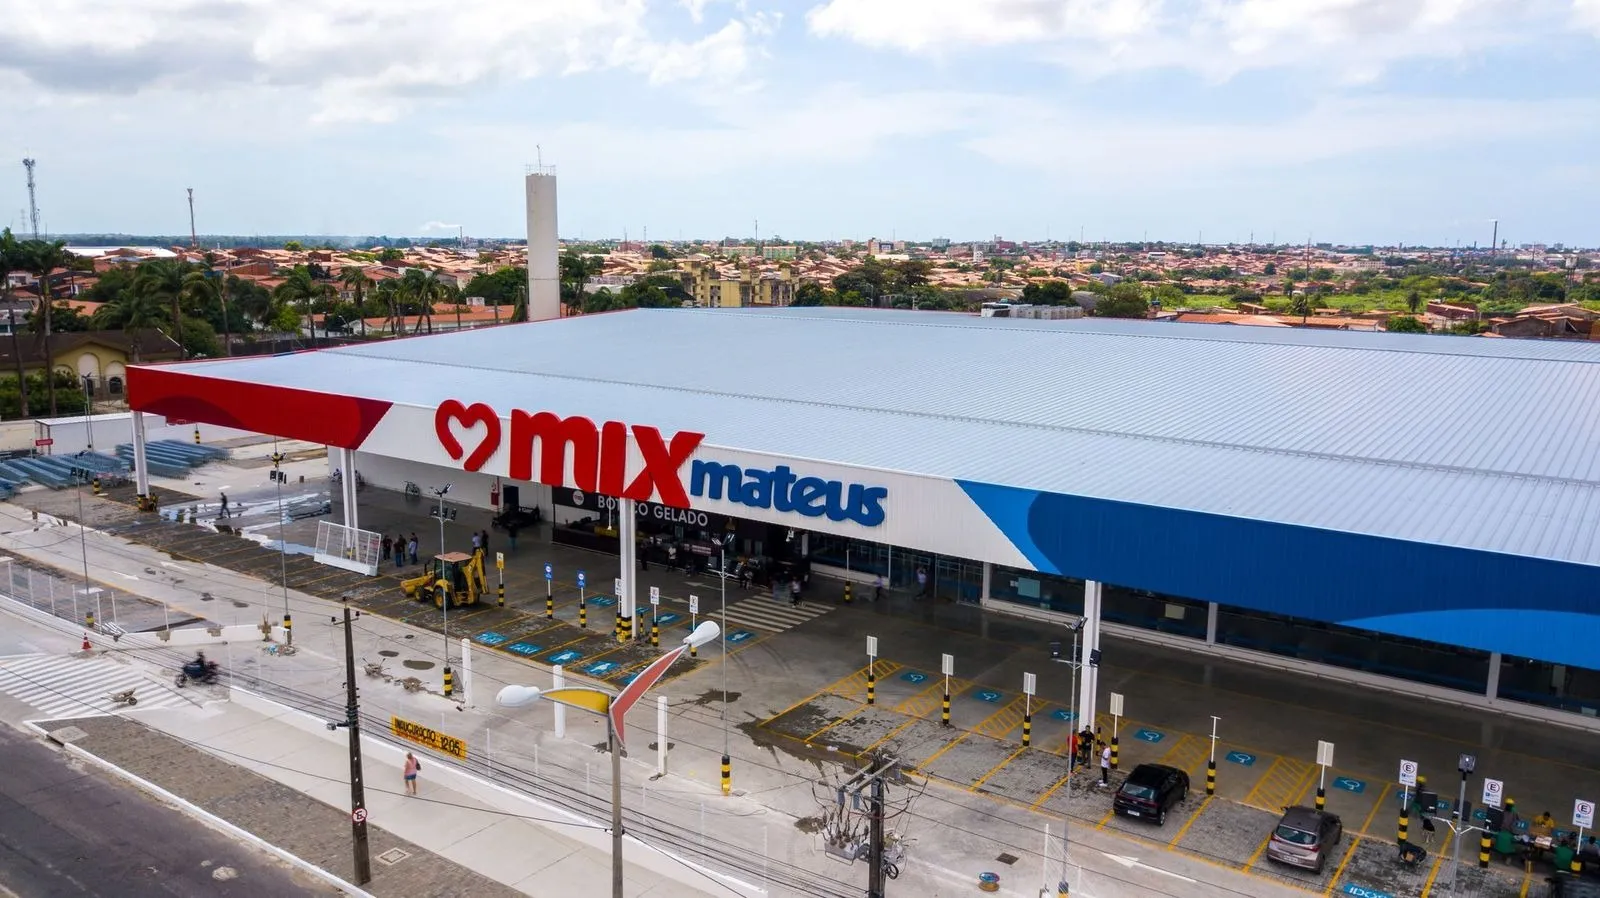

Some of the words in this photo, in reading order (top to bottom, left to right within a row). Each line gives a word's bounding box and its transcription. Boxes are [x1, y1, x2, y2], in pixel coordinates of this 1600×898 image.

[690, 459, 888, 527] mateus
[653, 505, 708, 527] GELADO
[509, 643, 538, 655] TAXI
